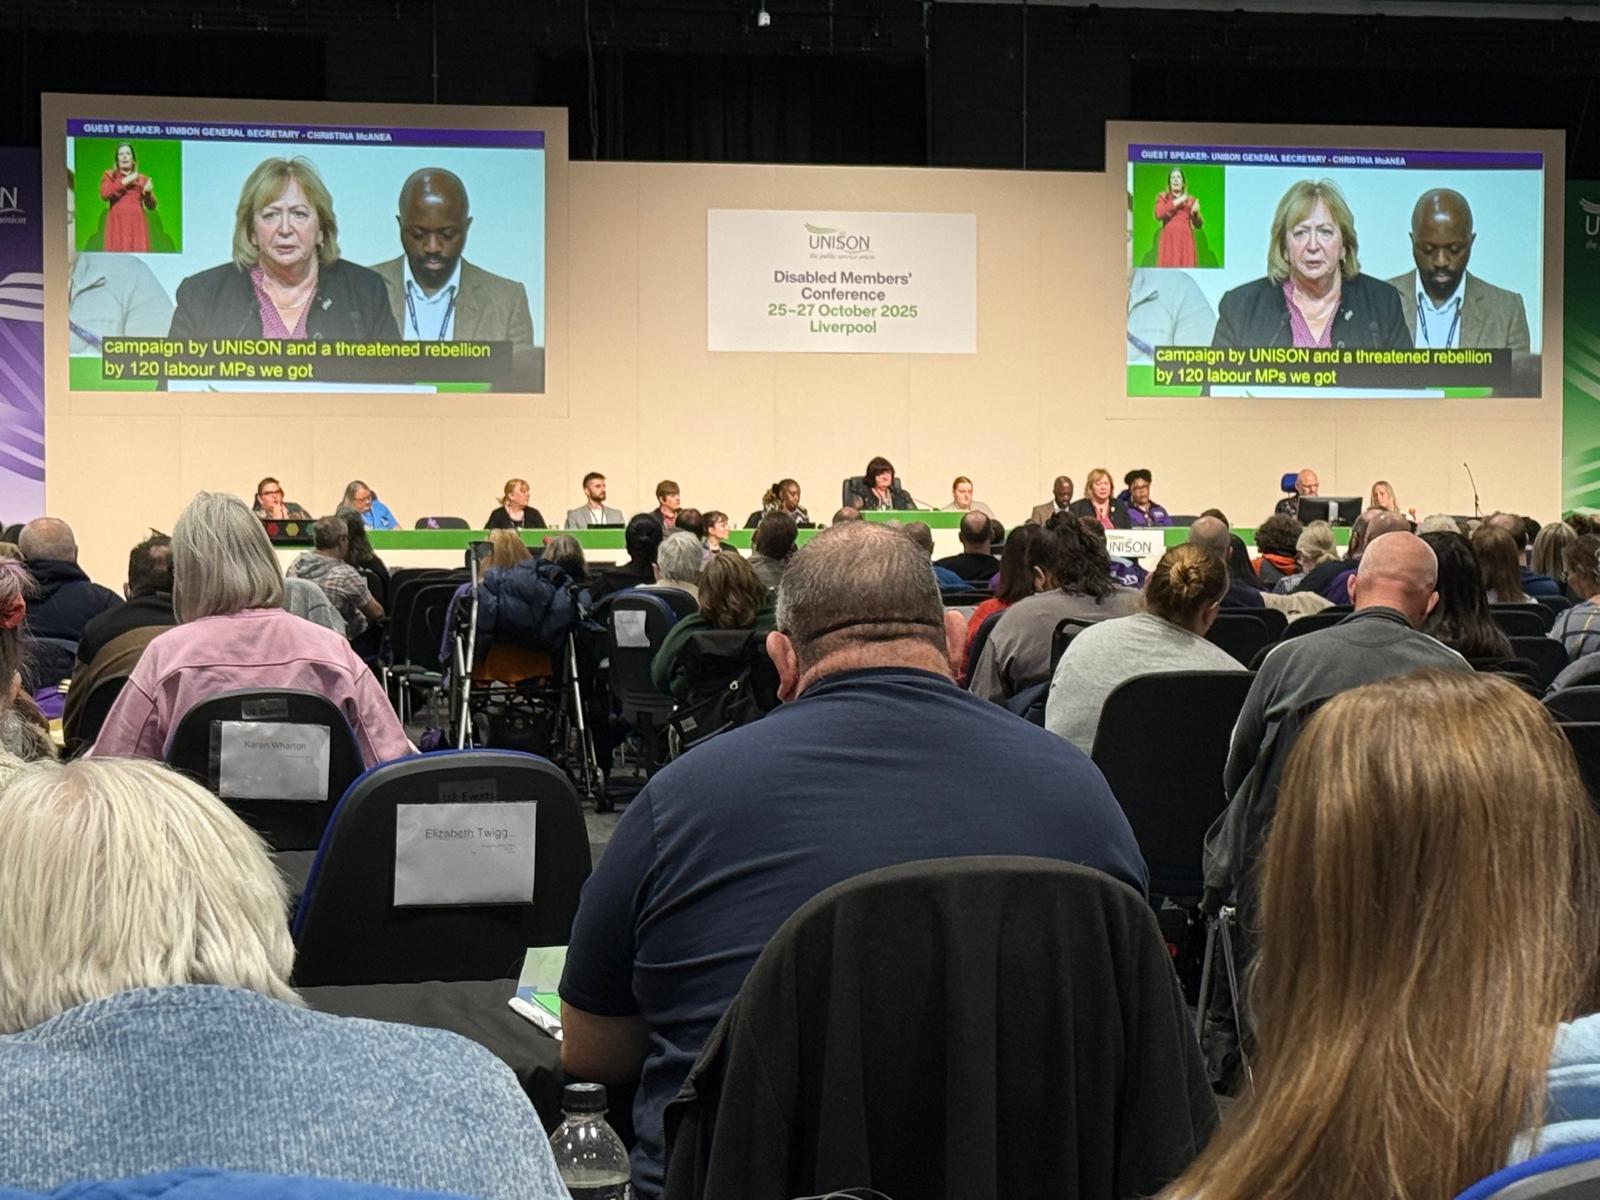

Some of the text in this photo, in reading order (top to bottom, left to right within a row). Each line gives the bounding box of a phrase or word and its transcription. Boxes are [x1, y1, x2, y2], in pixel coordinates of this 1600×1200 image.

[83, 124, 115, 133] GUEST
[165, 127, 199, 136] UNISON
[201, 128, 245, 137] GENERAL
[247, 128, 300, 139] SECRETARY
[307, 131, 354, 140] CHRISTINA
[355, 132, 393, 142] McANEA
[1141, 149, 1169, 159] GUEST
[1211, 152, 1241, 161] UNISON
[1242, 153, 1280, 162] GENERAL
[1281, 154, 1327, 163] SECRETARY
[1332, 155, 1374, 164] CHRISTINA
[809, 235, 871, 250] UNISON
[774, 270, 912, 285] Disabled Members'
[801, 286, 886, 301] Conference
[818, 304, 877, 318] October
[880, 304, 918, 318] 2025
[810, 320, 877, 336] Liverpool
[104, 340, 491, 357] campaign by UNISON and a threatened rebellion
[1156, 348, 1492, 365] campaign by UNISON and a threatened rebellion
[104, 361, 313, 380] by 120 labour MPs we got
[1156, 368, 1336, 386] by 120 labour MPs we got
[244, 740, 307, 751] Karen Wharton
[424, 827, 509, 840] Elizabeth Twigg
